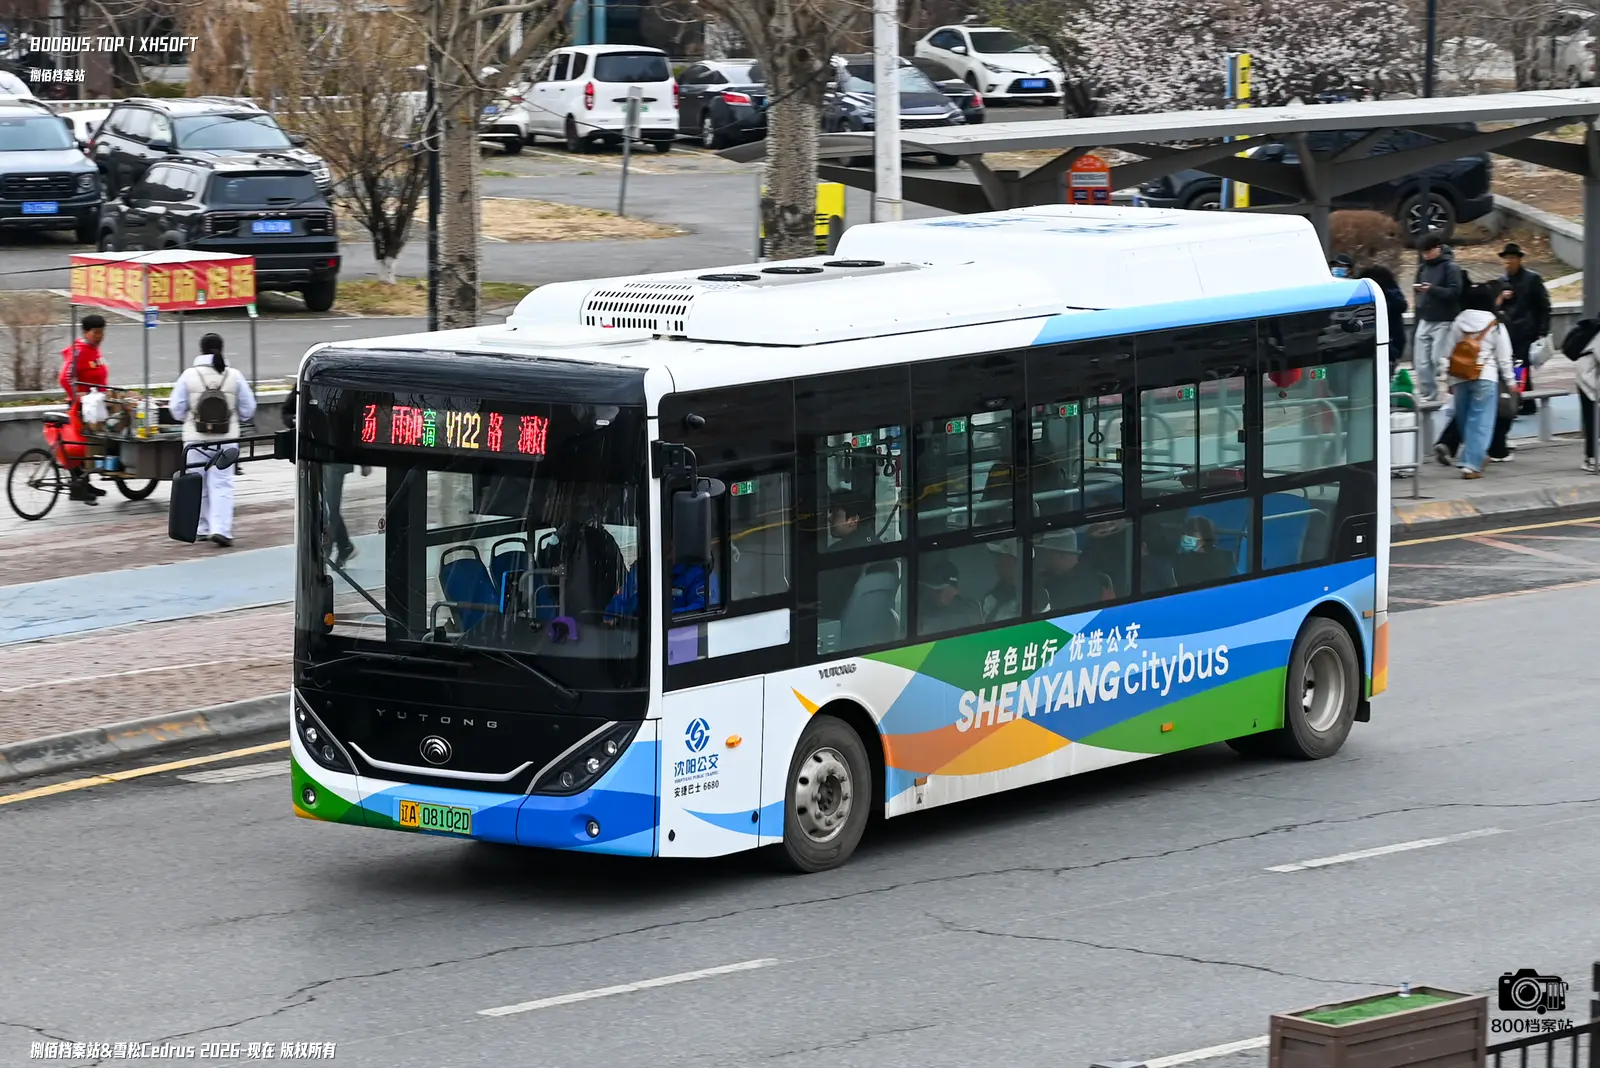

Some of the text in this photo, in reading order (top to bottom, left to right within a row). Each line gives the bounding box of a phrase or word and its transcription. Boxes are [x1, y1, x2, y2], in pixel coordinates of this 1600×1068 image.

[423, 409, 437, 447] 空调
[446, 411, 481, 449] V122
[982, 622, 1141, 680] 绿色出行 优选公交
[818, 663, 857, 680] YUTONG
[376, 707, 498, 729] YUTONG
[674, 754, 719, 777] 沈阳公交
[674, 783, 701, 798] 安捷巴士
[422, 807, 469, 830] 08102D
